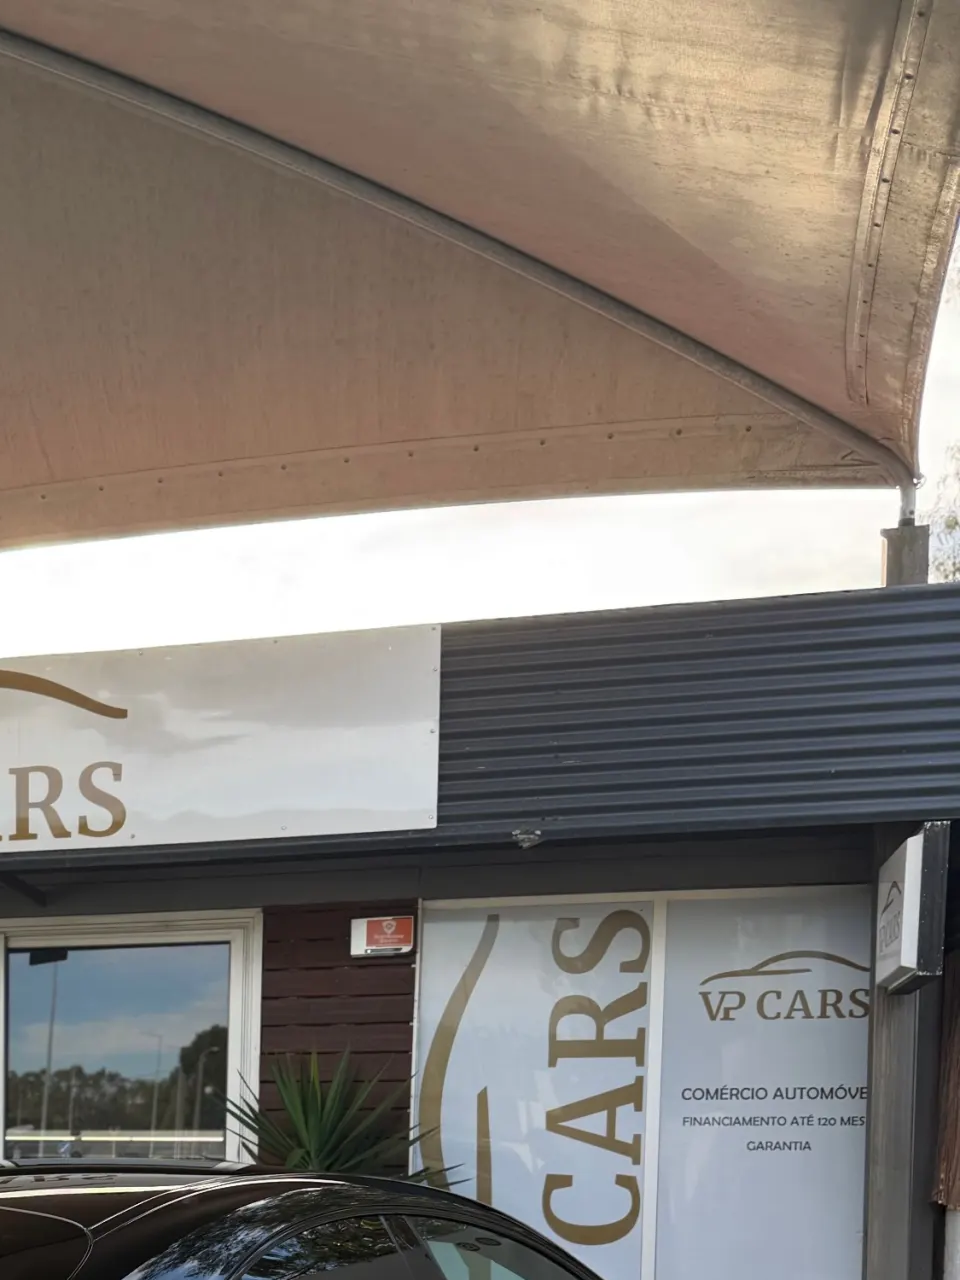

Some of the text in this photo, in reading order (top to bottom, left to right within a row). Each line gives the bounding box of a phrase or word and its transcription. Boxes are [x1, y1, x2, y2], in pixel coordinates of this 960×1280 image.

[698, 988, 871, 1021] VP CARS
[542, 909, 651, 1245] CARS
[681, 1085, 768, 1101] COMÉRCIO
[682, 1116, 787, 1127] FINANCIAMENTO
[790, 1114, 814, 1126] ATÉ
[818, 1117, 837, 1127] 120
[746, 1141, 812, 1151] GARANTIA
